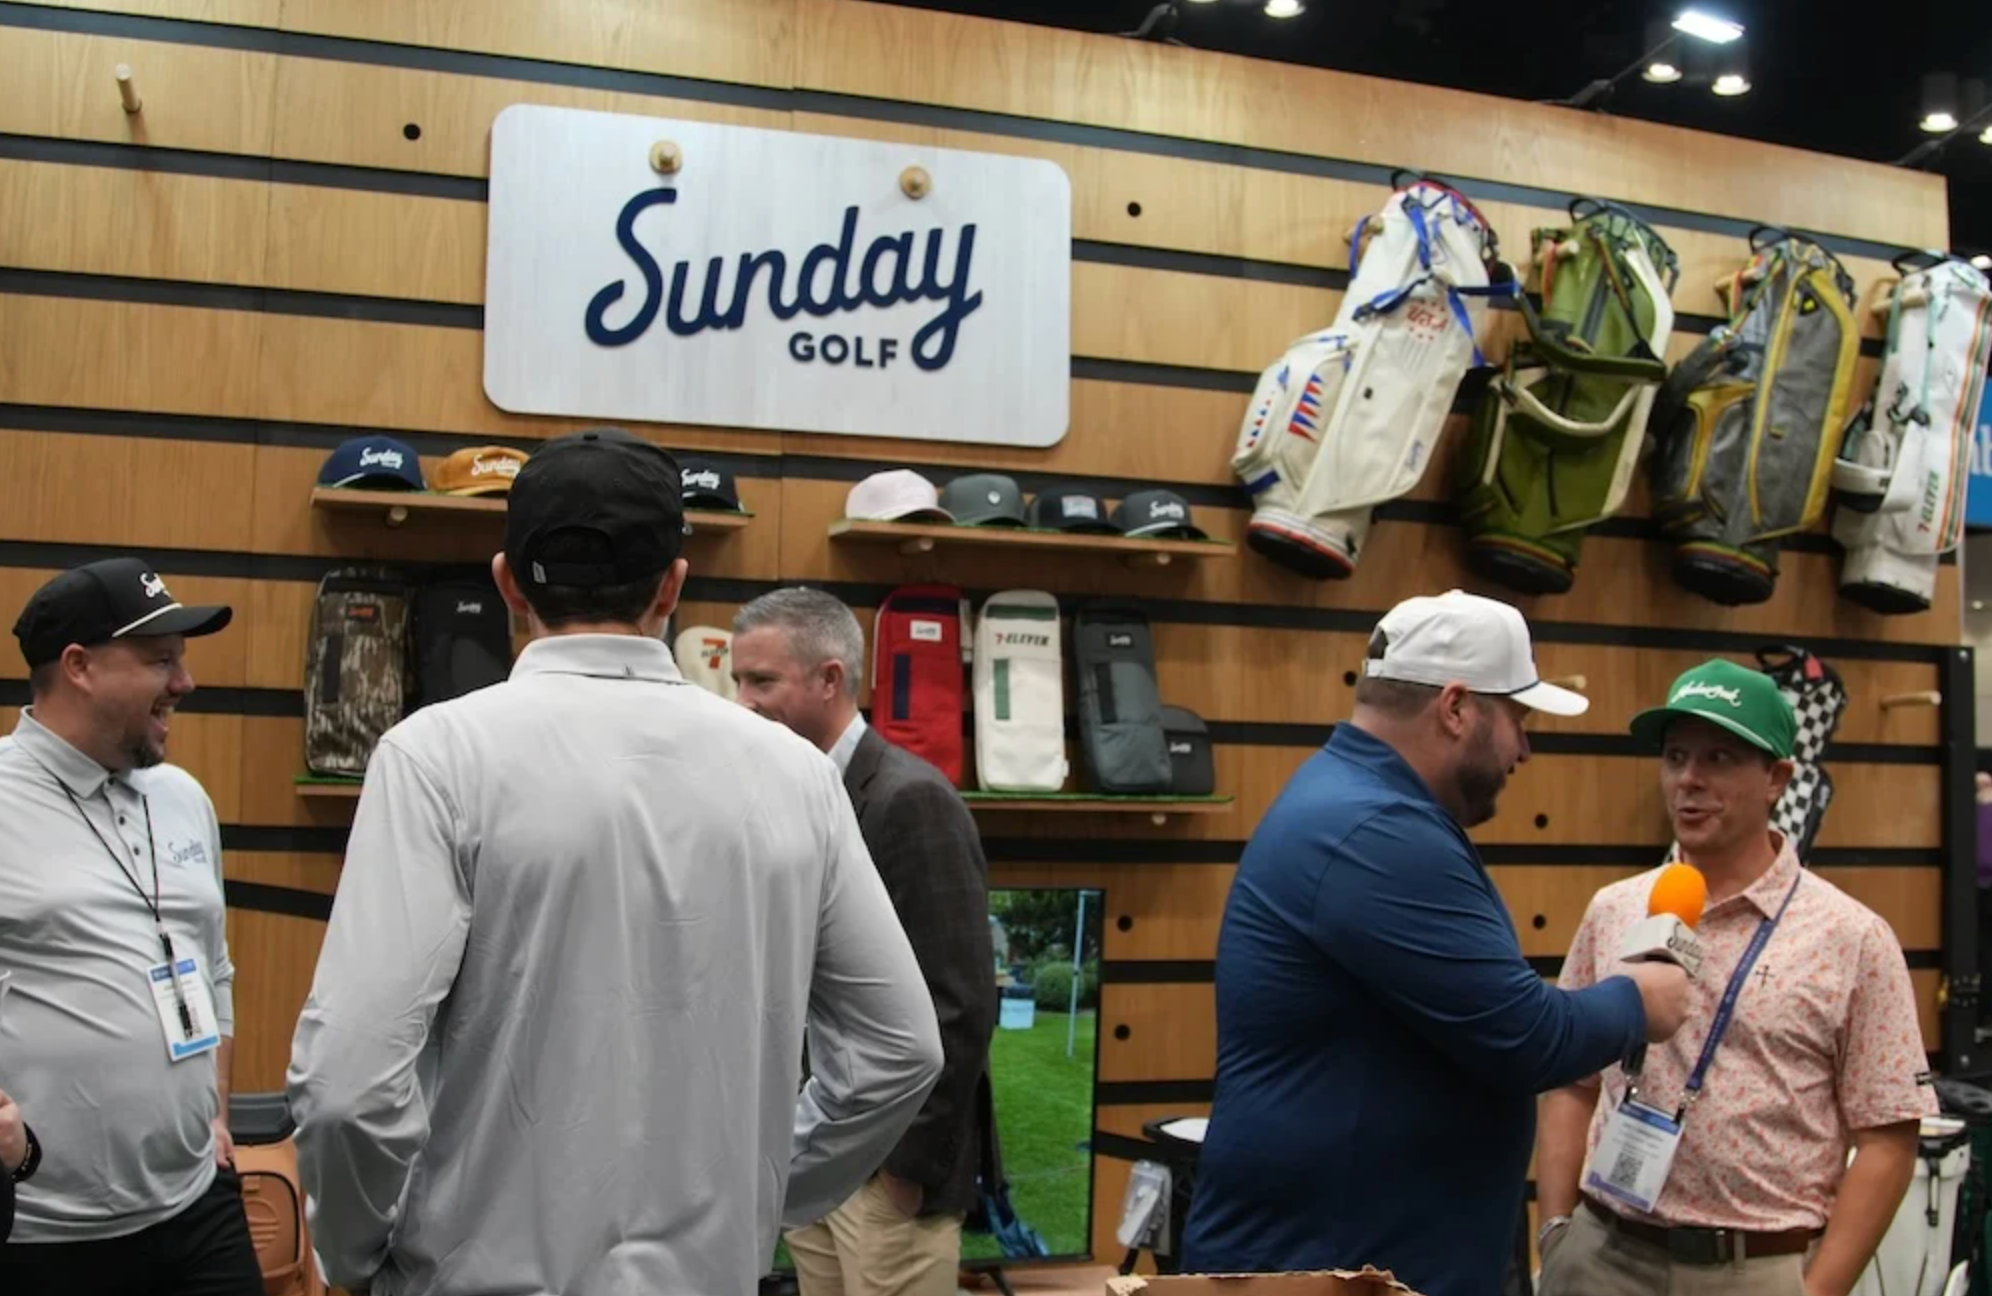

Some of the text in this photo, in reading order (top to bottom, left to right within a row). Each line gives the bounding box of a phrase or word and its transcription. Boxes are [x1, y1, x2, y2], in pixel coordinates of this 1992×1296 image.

[585, 188, 983, 371] Sunday
[788, 332, 899, 369] GOLF
[360, 447, 403, 469] Sunday
